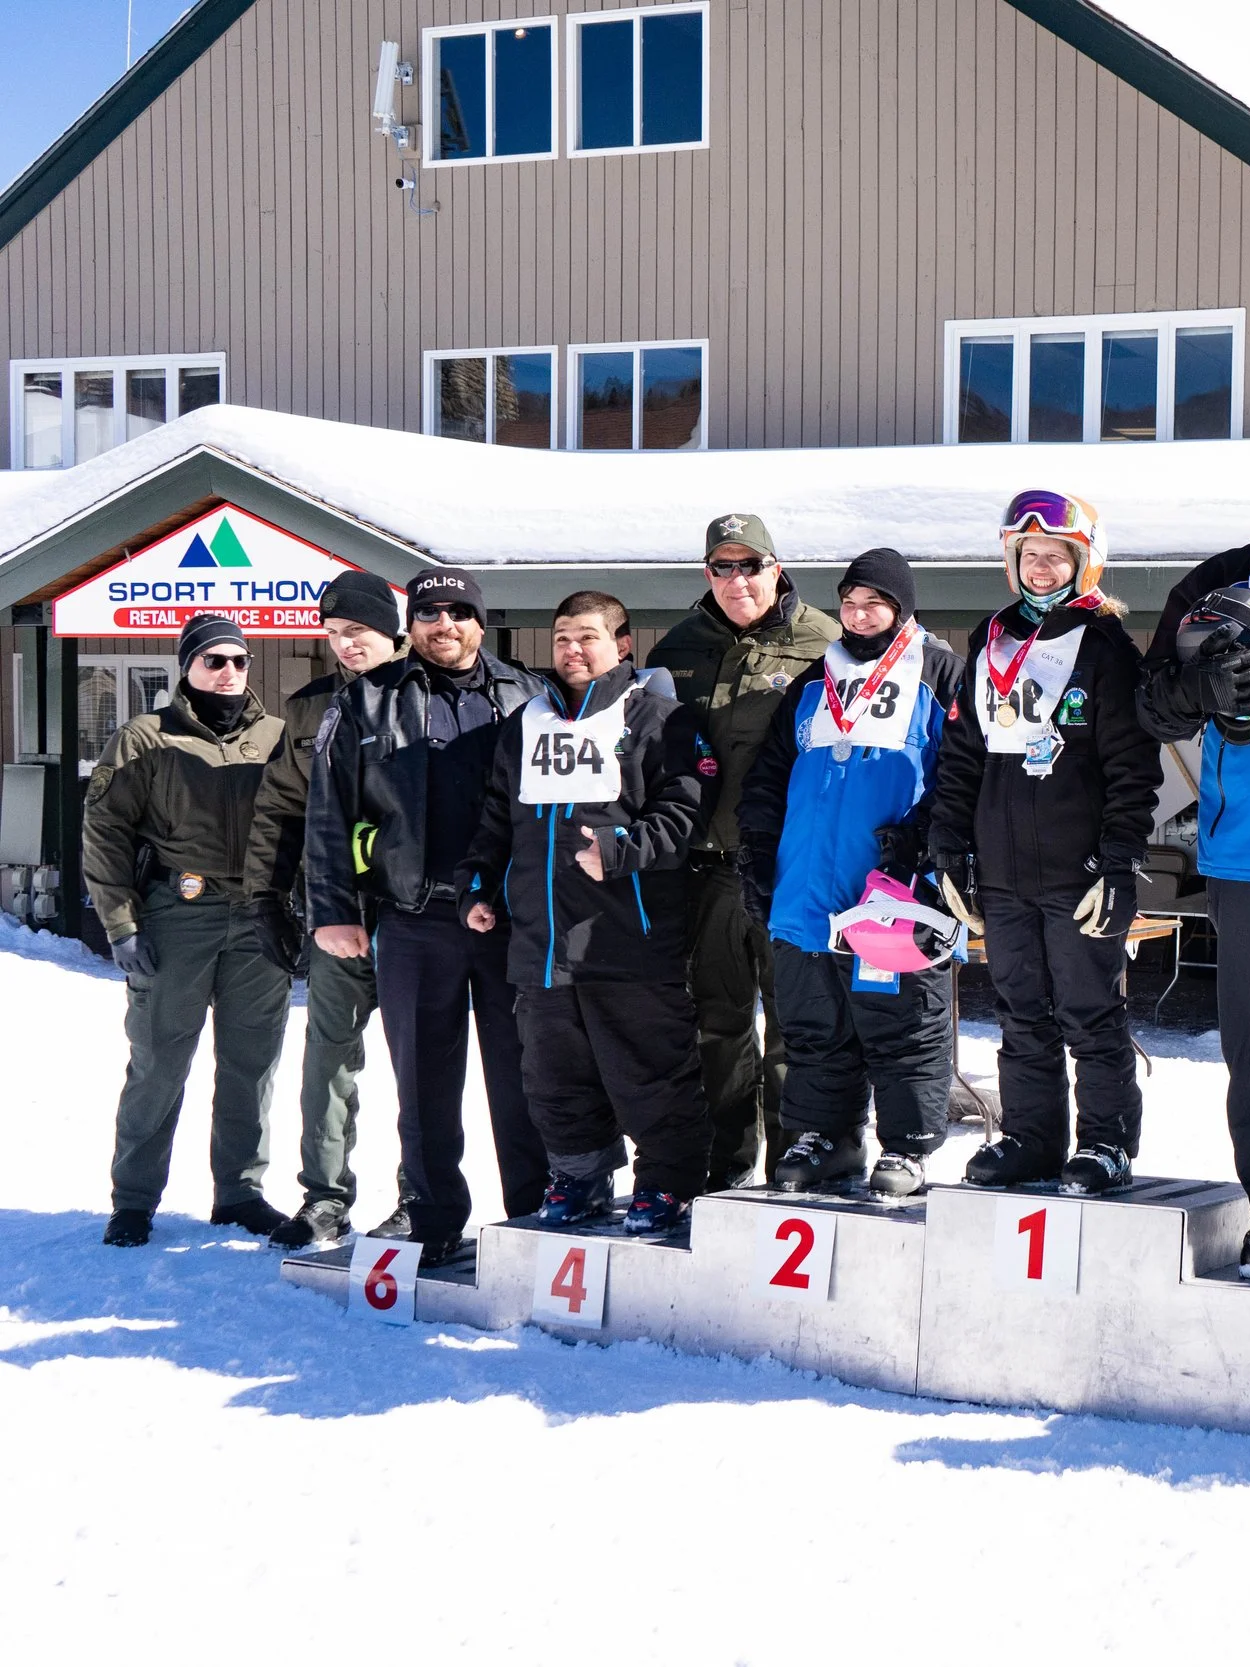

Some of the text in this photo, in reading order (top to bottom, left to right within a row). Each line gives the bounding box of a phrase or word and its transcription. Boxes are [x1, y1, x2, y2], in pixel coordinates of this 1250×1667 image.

[108, 581, 215, 601] SPORT
[416, 576, 465, 594] POLICE
[129, 610, 181, 625] RETAIL
[1041, 652, 1054, 662] CAT
[531, 733, 604, 775] 454
[769, 1218, 815, 1290] 2
[1017, 1208, 1047, 1280] 1
[364, 1248, 400, 1311] 6
[550, 1247, 588, 1314] 4
